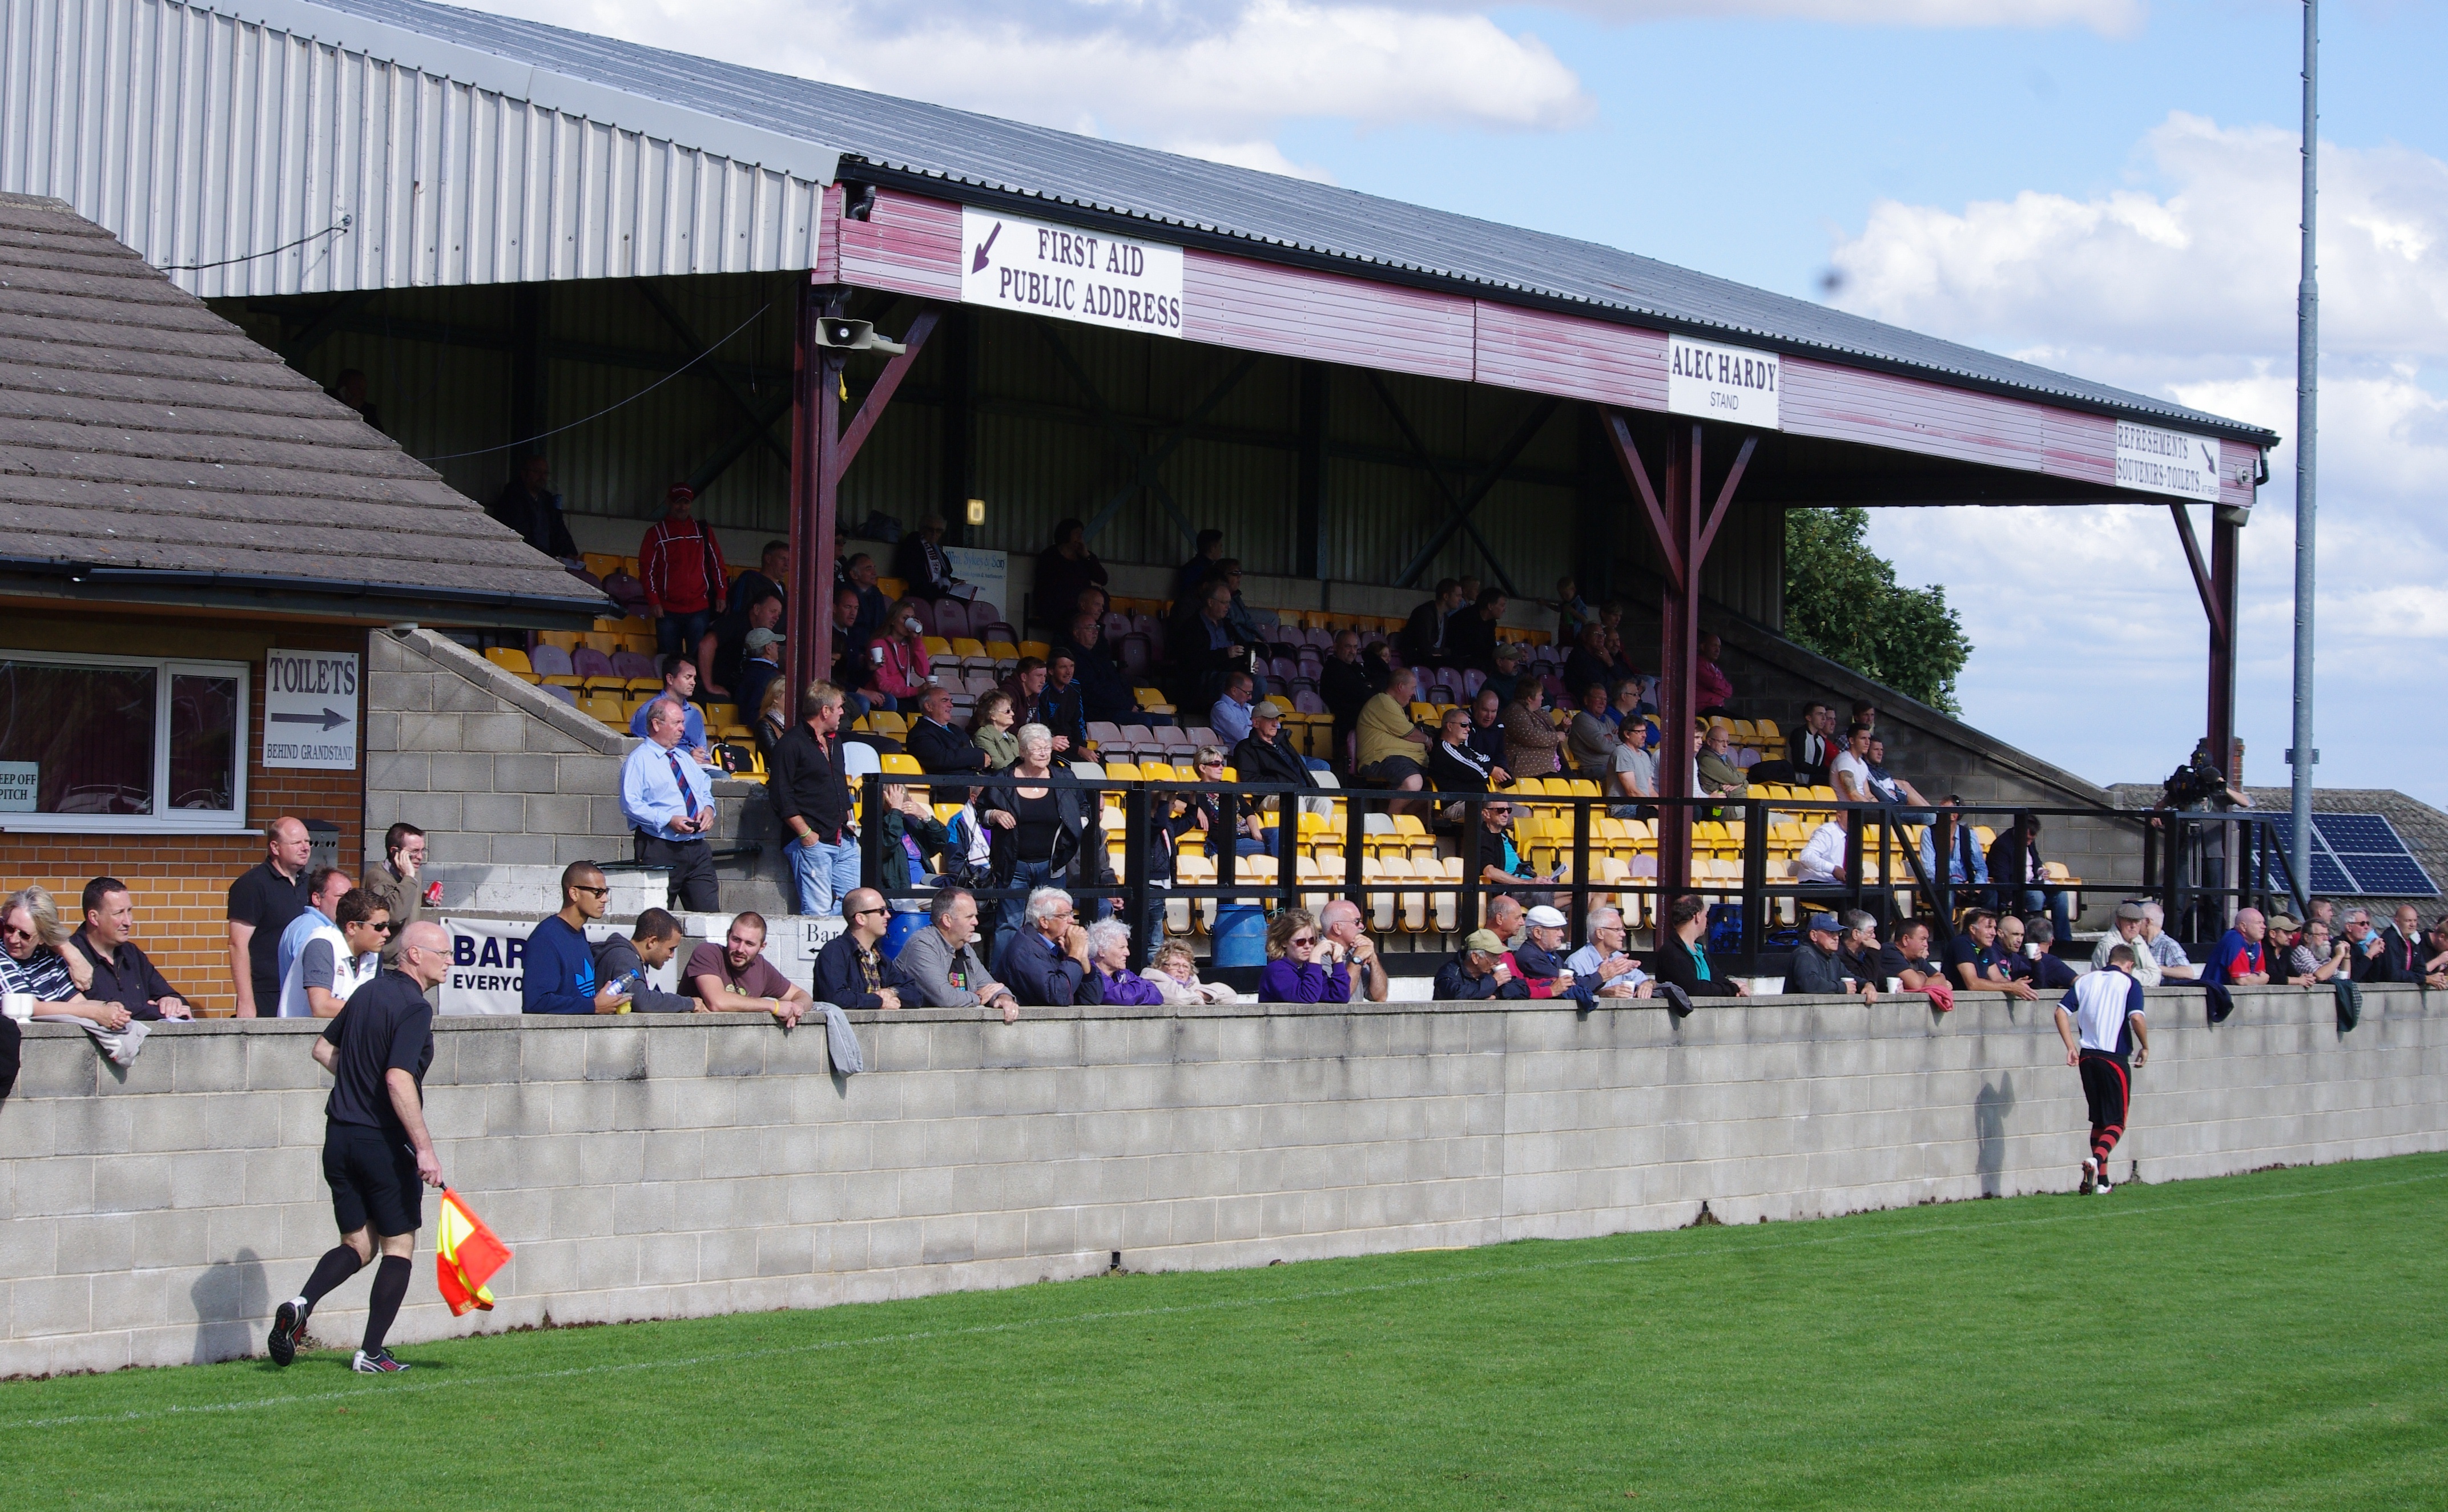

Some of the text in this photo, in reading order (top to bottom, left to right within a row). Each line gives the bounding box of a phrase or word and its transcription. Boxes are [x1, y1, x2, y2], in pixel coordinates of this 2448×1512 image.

[1038, 228, 1144, 277] FIRST AID
[999, 267, 1180, 329] PUBLIC ADDRESS
[1673, 345, 1777, 392] ALEC HARDY
[1710, 391, 1739, 410] STAND
[2117, 425, 2188, 459] REFRESHMENTS
[964, 552, 983, 569] Sykes
[992, 555, 1005, 570] Son
[269, 658, 356, 696] TOILETS
[267, 743, 354, 761] BEHIND GRANDSTAND
[18, 774, 36, 784] OFF
[807, 924, 839, 942] Bar
[453, 935, 527, 969] BAR
